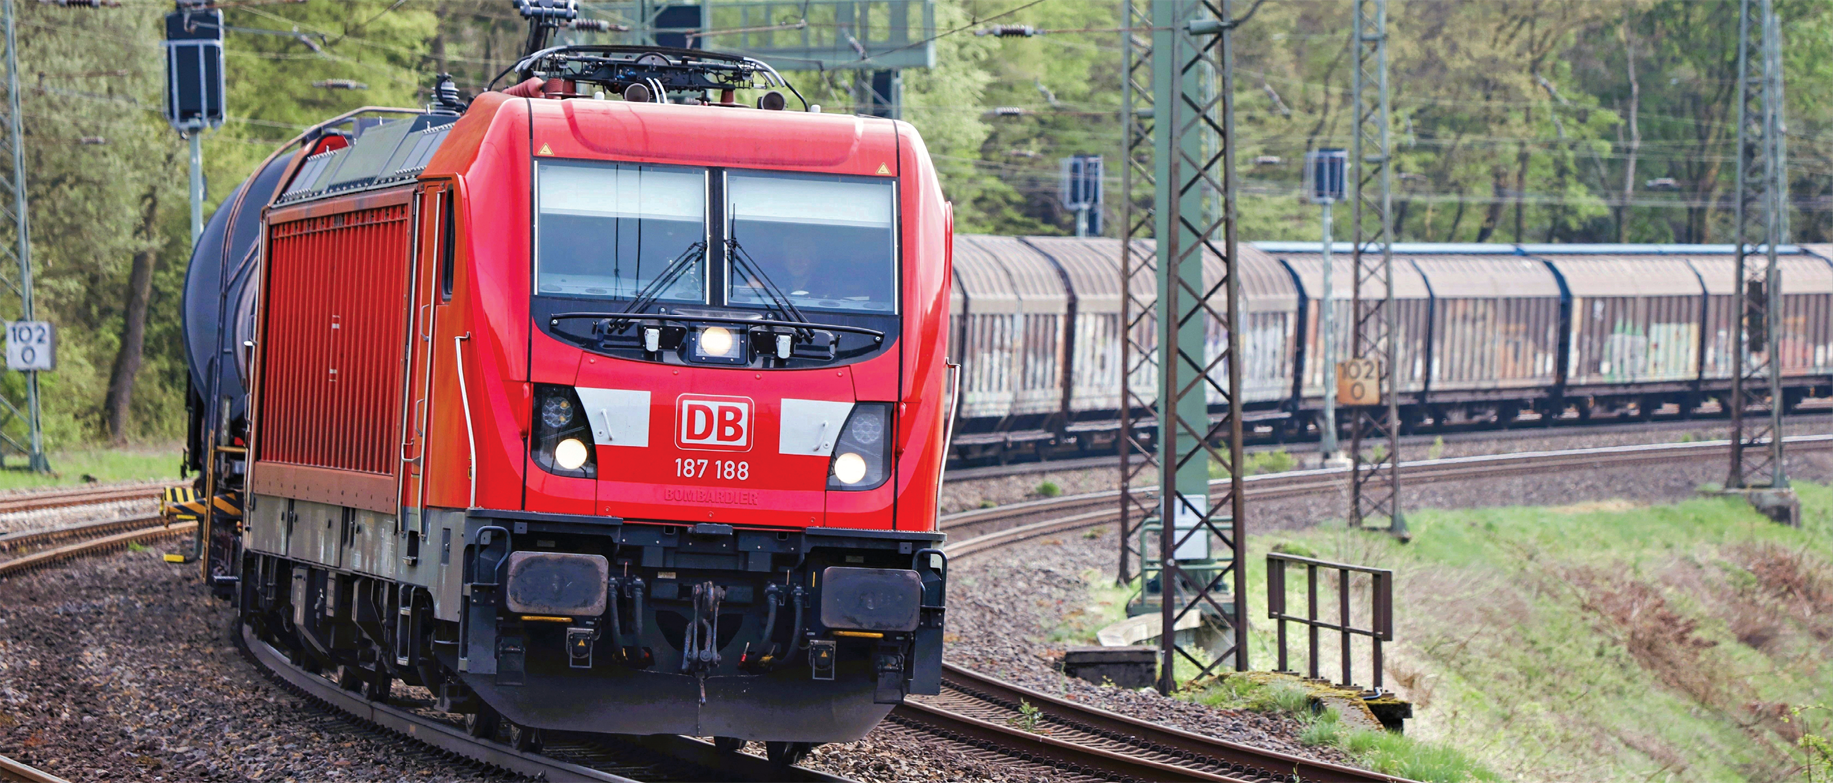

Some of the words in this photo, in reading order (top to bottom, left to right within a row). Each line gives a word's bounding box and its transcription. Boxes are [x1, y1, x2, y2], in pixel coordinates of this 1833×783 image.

[12, 325, 46, 345] 102
[21, 345, 36, 365] 0
[1341, 360, 1375, 380] 102
[1351, 381, 1365, 401] 0
[686, 403, 744, 442] DB
[675, 458, 709, 478] 187
[715, 460, 749, 481] 188
[664, 488, 759, 506] BOMBARDIER
